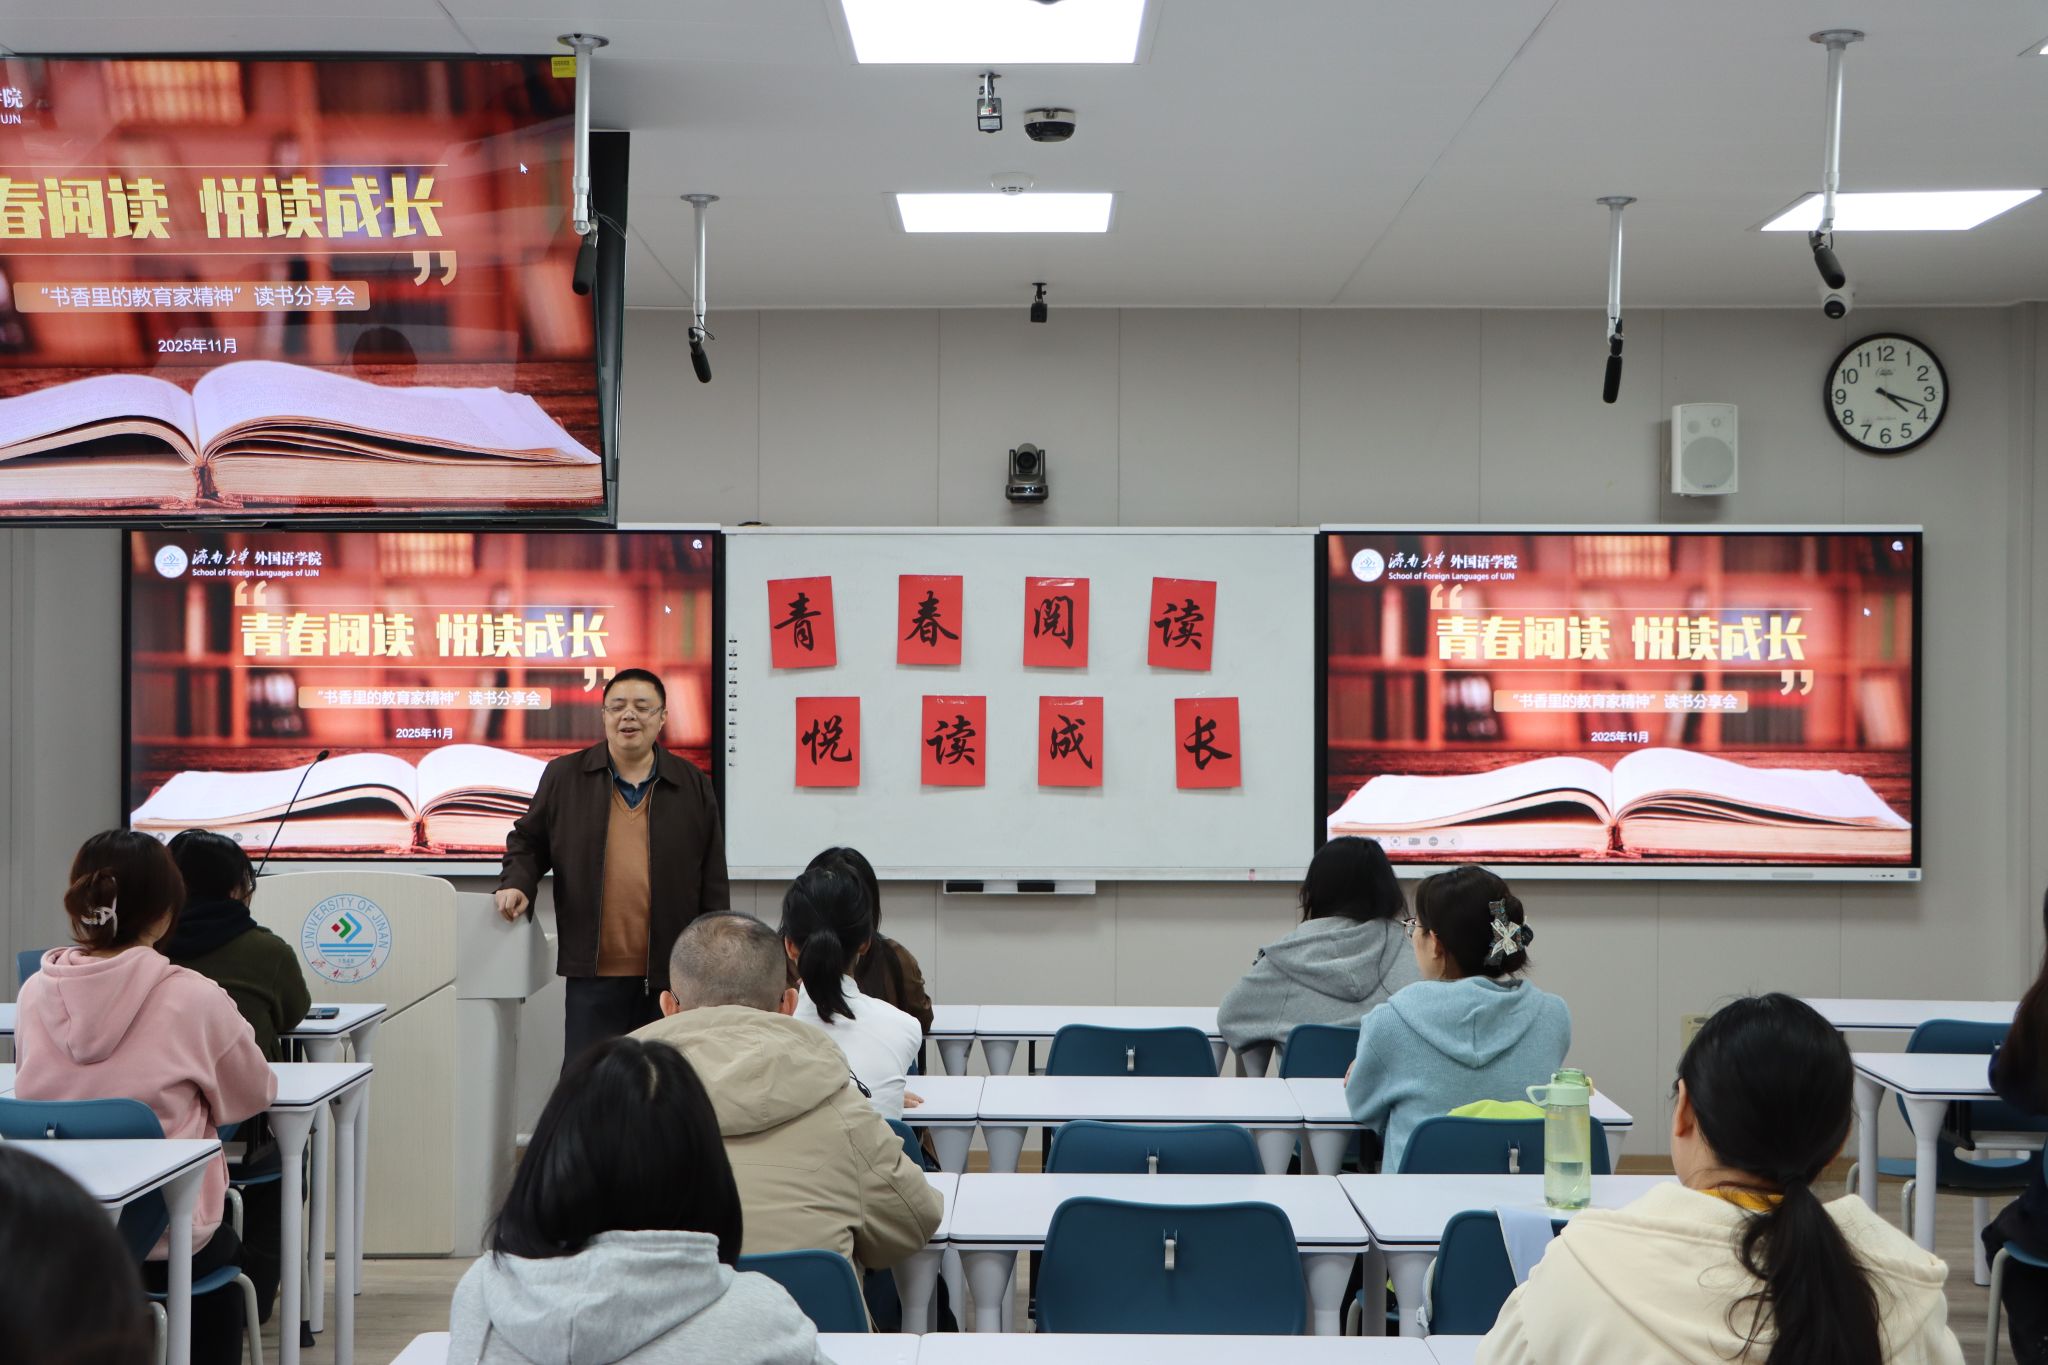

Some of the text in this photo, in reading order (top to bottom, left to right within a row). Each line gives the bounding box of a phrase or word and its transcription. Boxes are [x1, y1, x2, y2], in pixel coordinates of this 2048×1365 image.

[0, 114, 21, 124] UJN
[199, 175, 443, 238] 悦读成长
[158, 338, 237, 354] 2025年11月
[1877, 346, 1895, 361] 12
[1858, 352, 1870, 367] 11
[1906, 351, 1911, 366] 1
[1841, 368, 1858, 384] 10
[1917, 365, 1929, 381] 2
[1835, 389, 1846, 404] 9
[1924, 386, 1935, 402] 3
[1843, 410, 1854, 425] 8
[1917, 407, 1928, 422] 4
[1860, 425, 1872, 440] 7
[1880, 428, 1892, 444] 6
[1900, 423, 1912, 438] 5
[255, 550, 322, 566] 外国语学院
[1450, 554, 1518, 570] 外国语学院
[192, 568, 320, 579] School of Foreign Languages of UJN
[1388, 571, 1515, 582] School of Foreign Languages of UJN
[774, 592, 821, 651] 青
[906, 590, 959, 647] 春
[1154, 598, 1204, 650] 读
[241, 612, 608, 658] 青春阅读 悦读成长
[1436, 615, 1807, 660] 青春阅读 悦读成长
[395, 727, 453, 740] 2025年11月
[1590, 731, 1649, 744] 2025年11月
[801, 715, 1233, 770] 悦 读 成 长
[304, 897, 390, 949] UNIVERSITY OF JINAN
